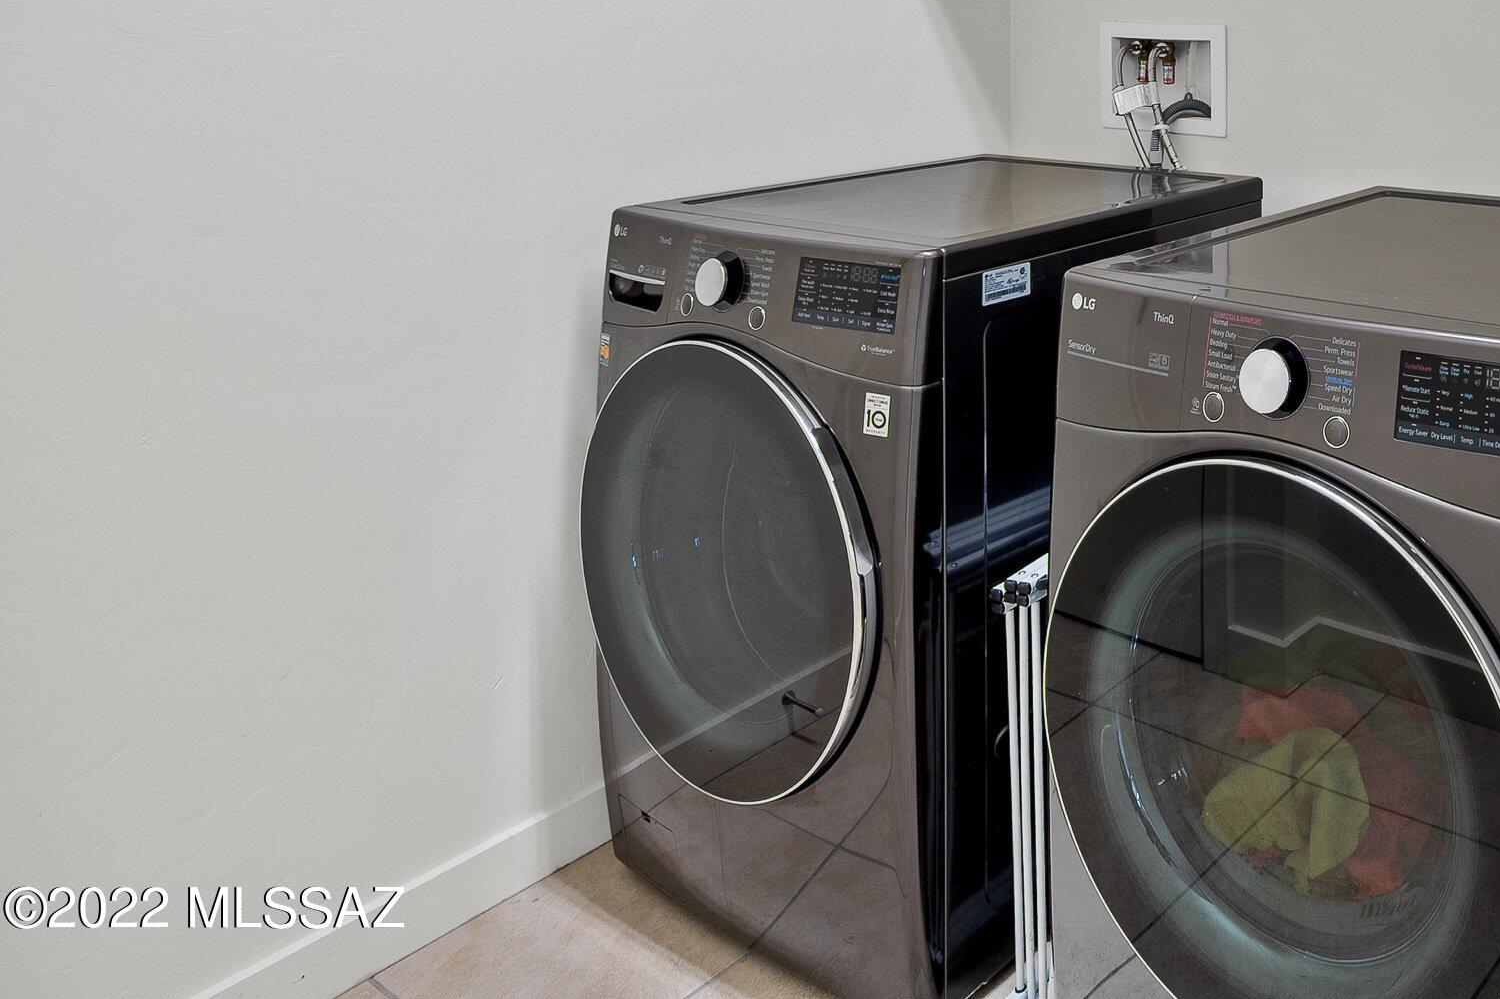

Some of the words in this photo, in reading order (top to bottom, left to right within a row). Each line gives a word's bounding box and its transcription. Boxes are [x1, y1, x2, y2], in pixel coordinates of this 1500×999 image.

[620, 227, 628, 236] LG
[1083, 297, 1096, 311] LG
[1153, 311, 1175, 324] ThinQ
[1211, 328, 1224, 338] Heavy
[1225, 330, 1237, 340] Duty
[1332, 337, 1356, 347] Delicates
[1221, 351, 1233, 360] Load
[1341, 348, 1355, 357] Press
[1343, 386, 1352, 395] Dry
[1342, 396, 1352, 406] Dry
[1401, 405, 1416, 413] Reduce
[867, 409, 886, 429] 10
[1398, 426, 1414, 436] Energy
[1431, 432, 1440, 440] Dry
[1441, 433, 1453, 441] Level
[1482, 439, 1494, 448] Time
